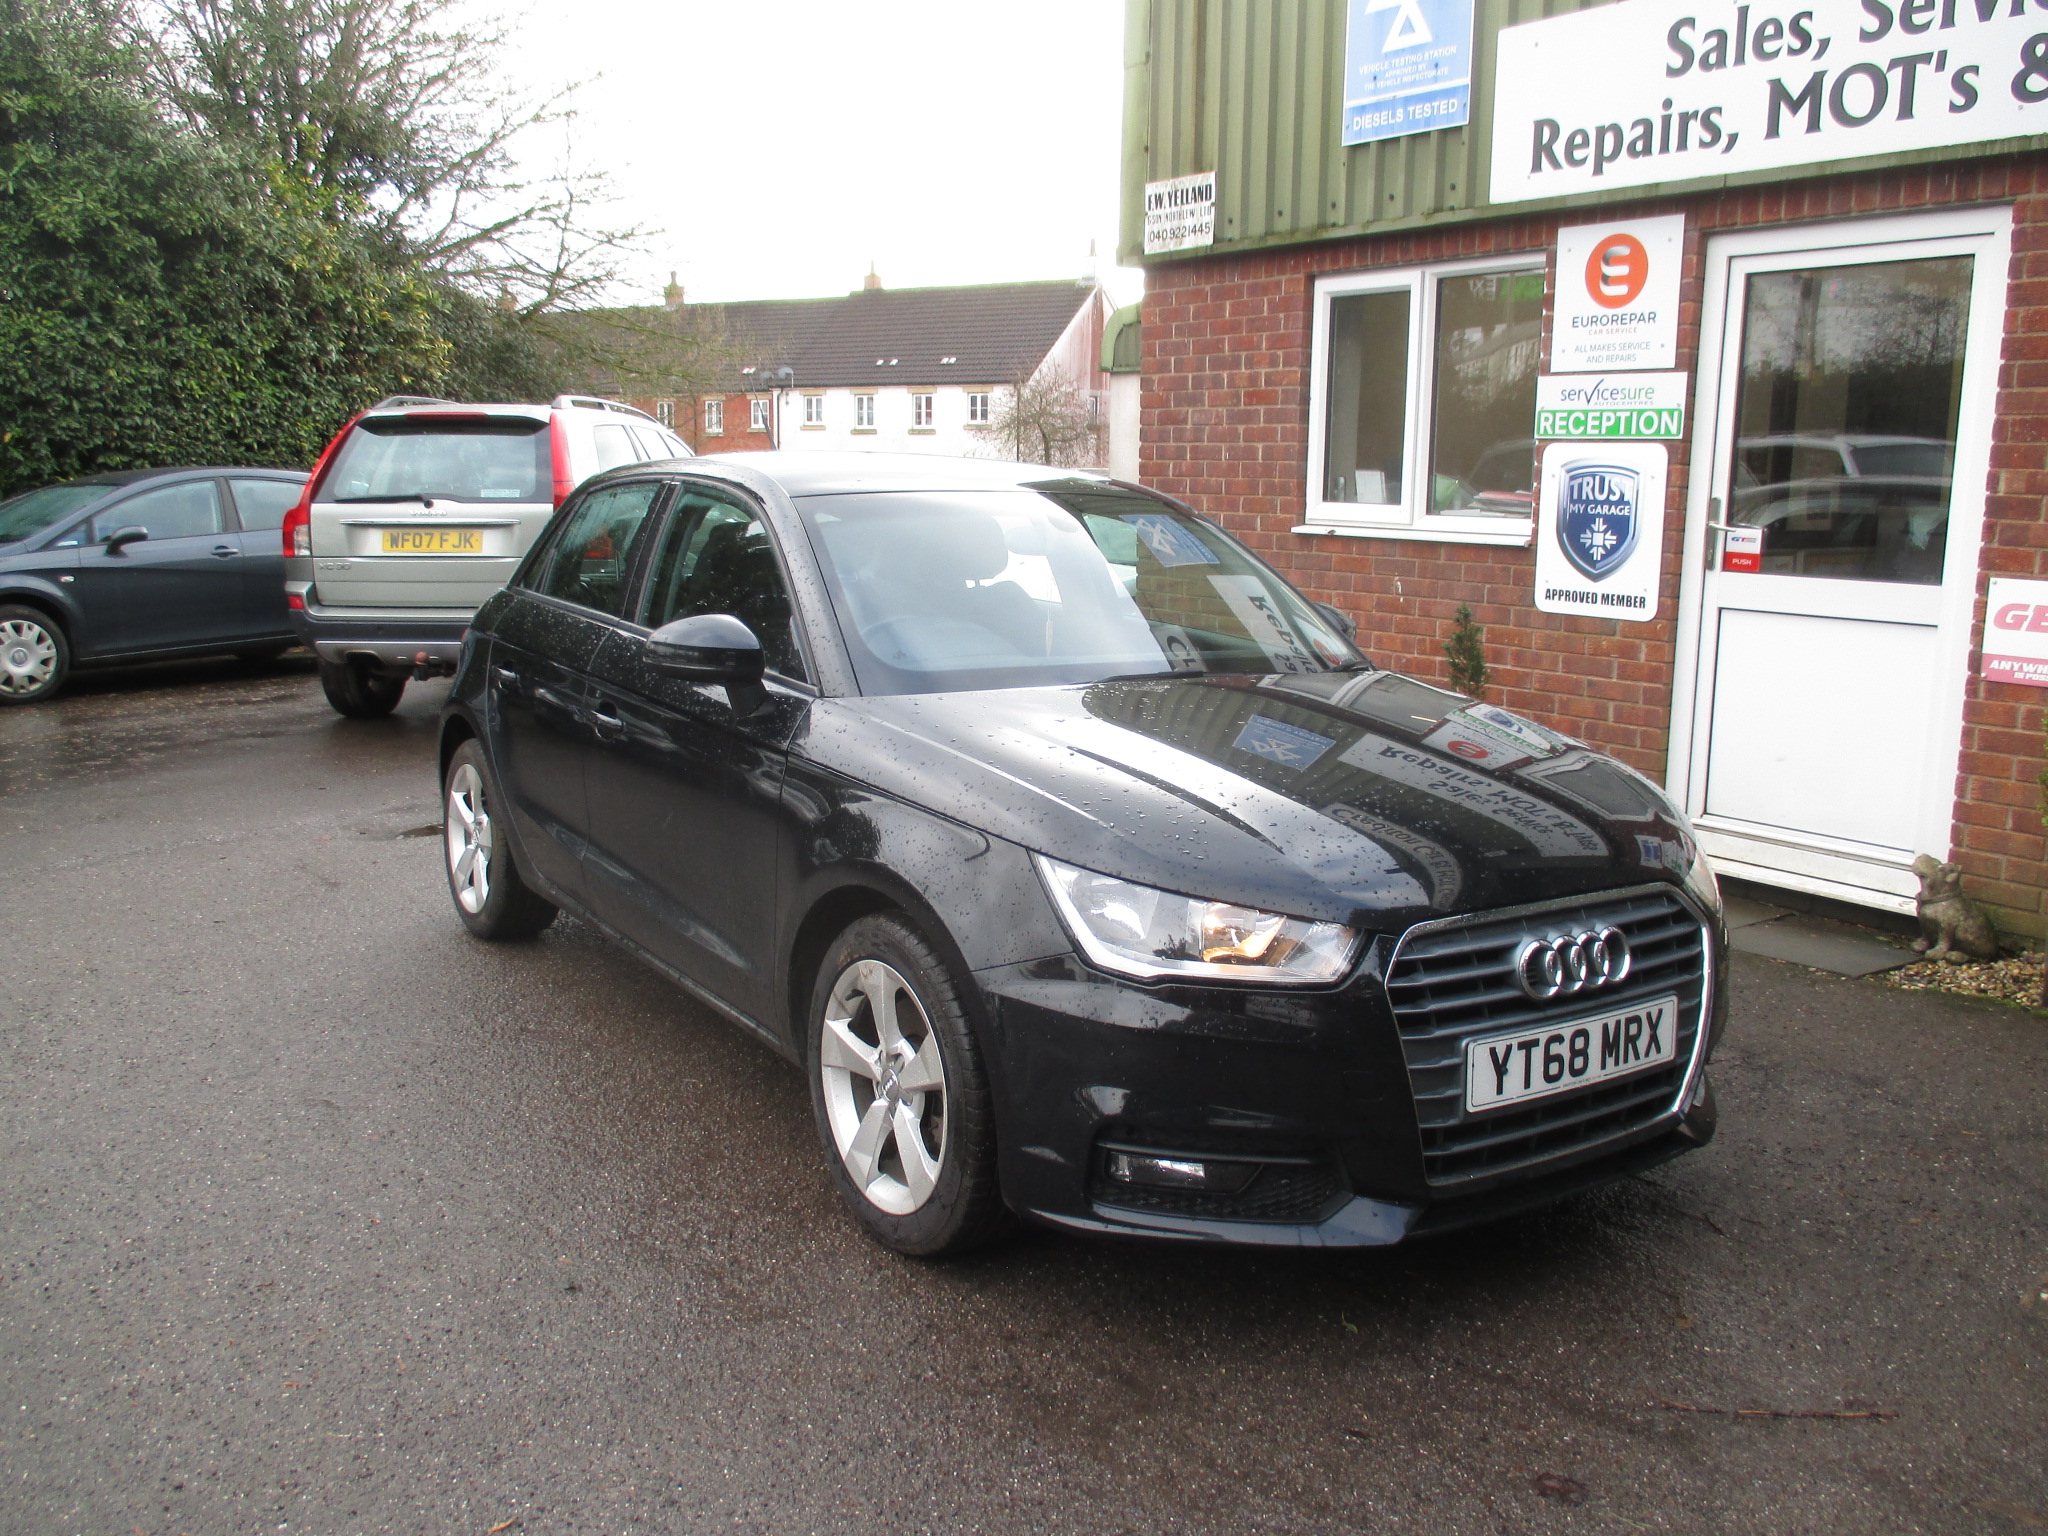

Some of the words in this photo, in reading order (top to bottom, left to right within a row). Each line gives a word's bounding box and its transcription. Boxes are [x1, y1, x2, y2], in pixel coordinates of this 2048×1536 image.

[1665, 3, 1831, 79] Sales,
[1359, 62, 1389, 75] VEHICLE
[1391, 54, 1422, 68] TESTING
[1424, 46, 1457, 60] STATION
[1385, 66, 1417, 79] APPROVED
[1417, 63, 1427, 71] BY
[1377, 77, 1401, 89] VEHICLE
[1402, 67, 1449, 83] INSPECTORATE
[1353, 108, 1404, 131] DIESELS
[1407, 99, 1458, 120] TESTED
[1529, 97, 1739, 177] Repairs,
[1763, 49, 1980, 141] MOT's
[2010, 32, 2048, 103] &
[1572, 311, 1657, 328] EUROREPAR
[1605, 327, 1638, 335] SERVICE
[1574, 345, 1588, 353] ALL
[1589, 343, 1617, 352] MAKES
[1618, 341, 1651, 351] SERVICE
[1586, 355, 1604, 364] AND
[1605, 353, 1637, 363] REPAIRS
[1561, 379, 1655, 405] servicesure
[1539, 410, 1680, 435] RECEPTION
[1570, 475, 1633, 504] TRUST
[1569, 503, 1585, 514] MY
[1587, 503, 1631, 516] GARAGE
[390, 532, 434, 549] WF07
[439, 532, 474, 549] FJK
[1545, 588, 1598, 605] APPROVED
[1600, 593, 1646, 609] MEMBER
[1489, 1028, 1590, 1096] YT68
[1600, 1008, 1664, 1070] MRX
